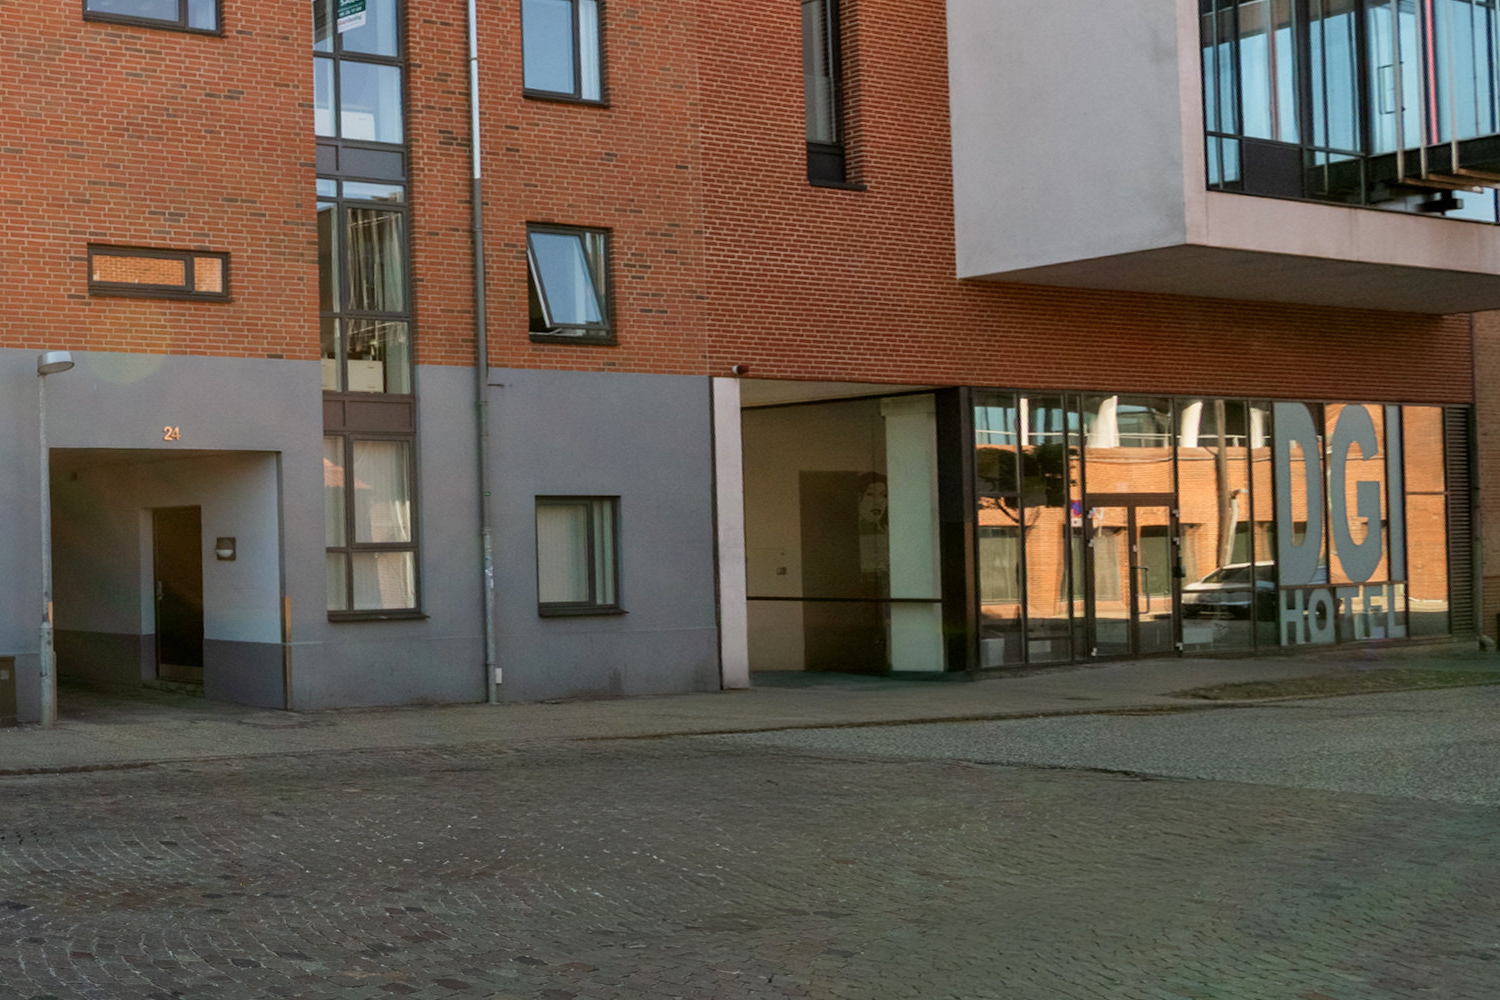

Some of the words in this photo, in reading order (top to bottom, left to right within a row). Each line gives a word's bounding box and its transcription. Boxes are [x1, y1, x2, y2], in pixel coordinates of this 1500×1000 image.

[164, 426, 180, 441] 24
[1273, 402, 1405, 585] DGI
[1279, 585, 1407, 647] HOTEL
